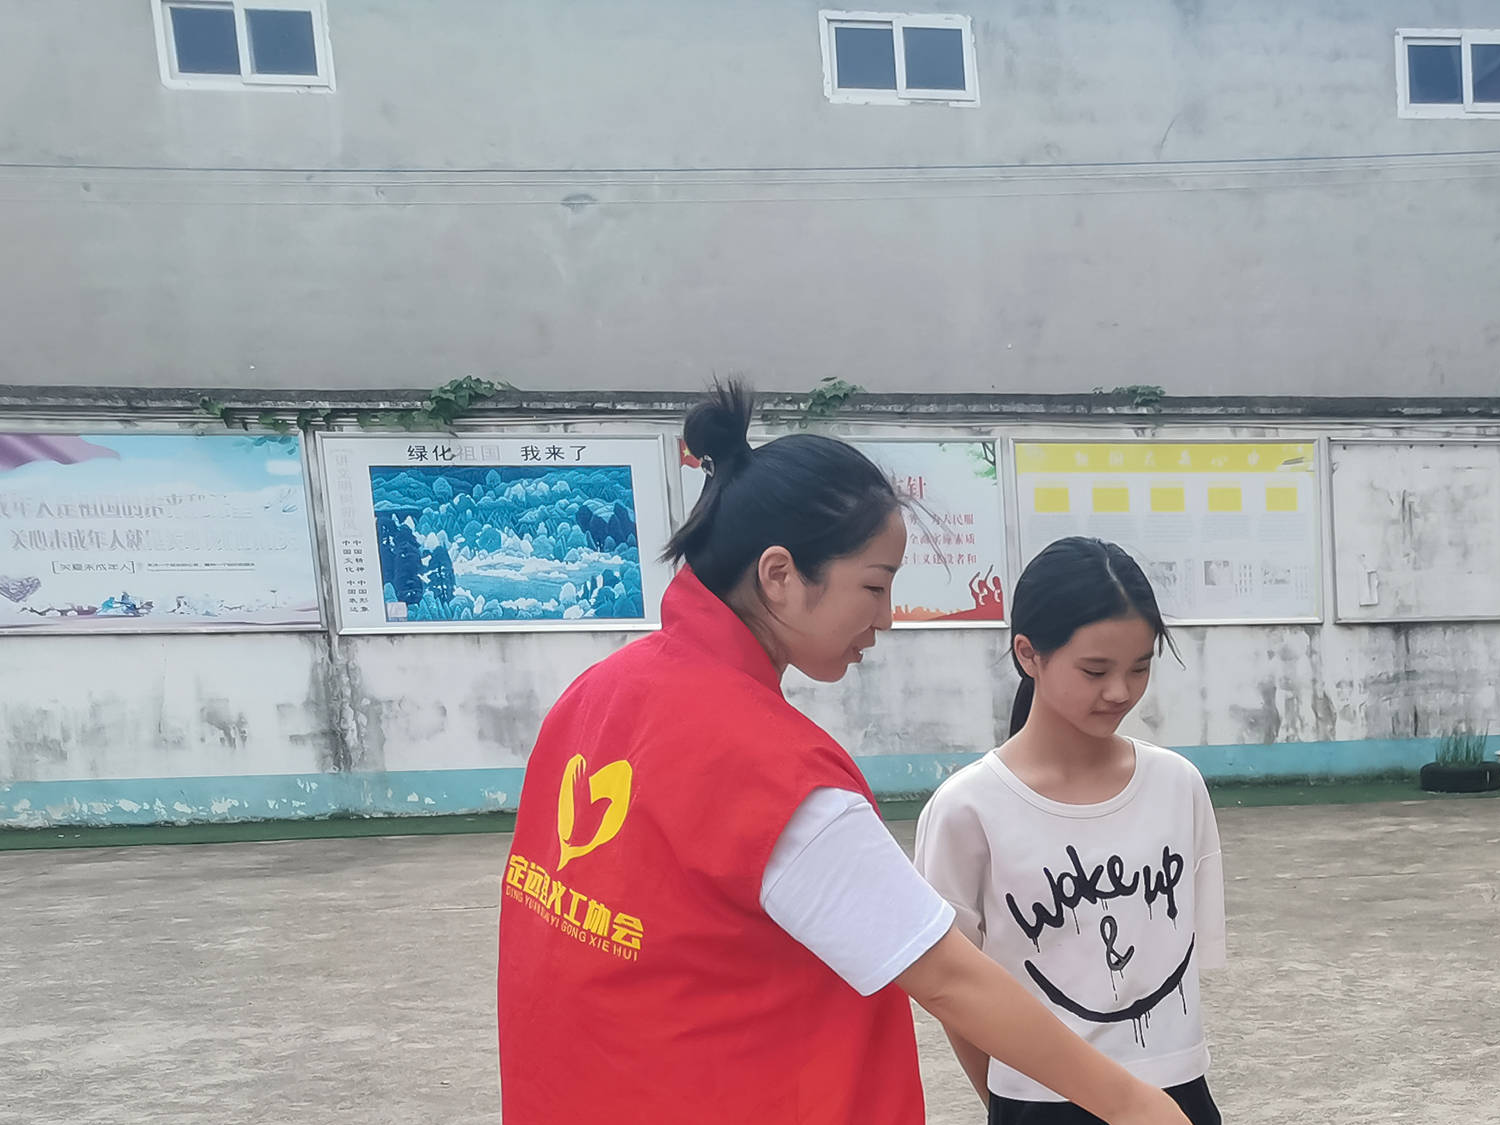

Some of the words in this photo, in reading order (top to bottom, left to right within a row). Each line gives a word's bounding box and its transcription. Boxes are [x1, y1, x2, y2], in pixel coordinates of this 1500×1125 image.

[520, 445, 588, 462] 我来了
[560, 922, 587, 942] GONG
[588, 934, 611, 953] XIE
[613, 945, 639, 961] HUI
[1100, 915, 1135, 971] &
